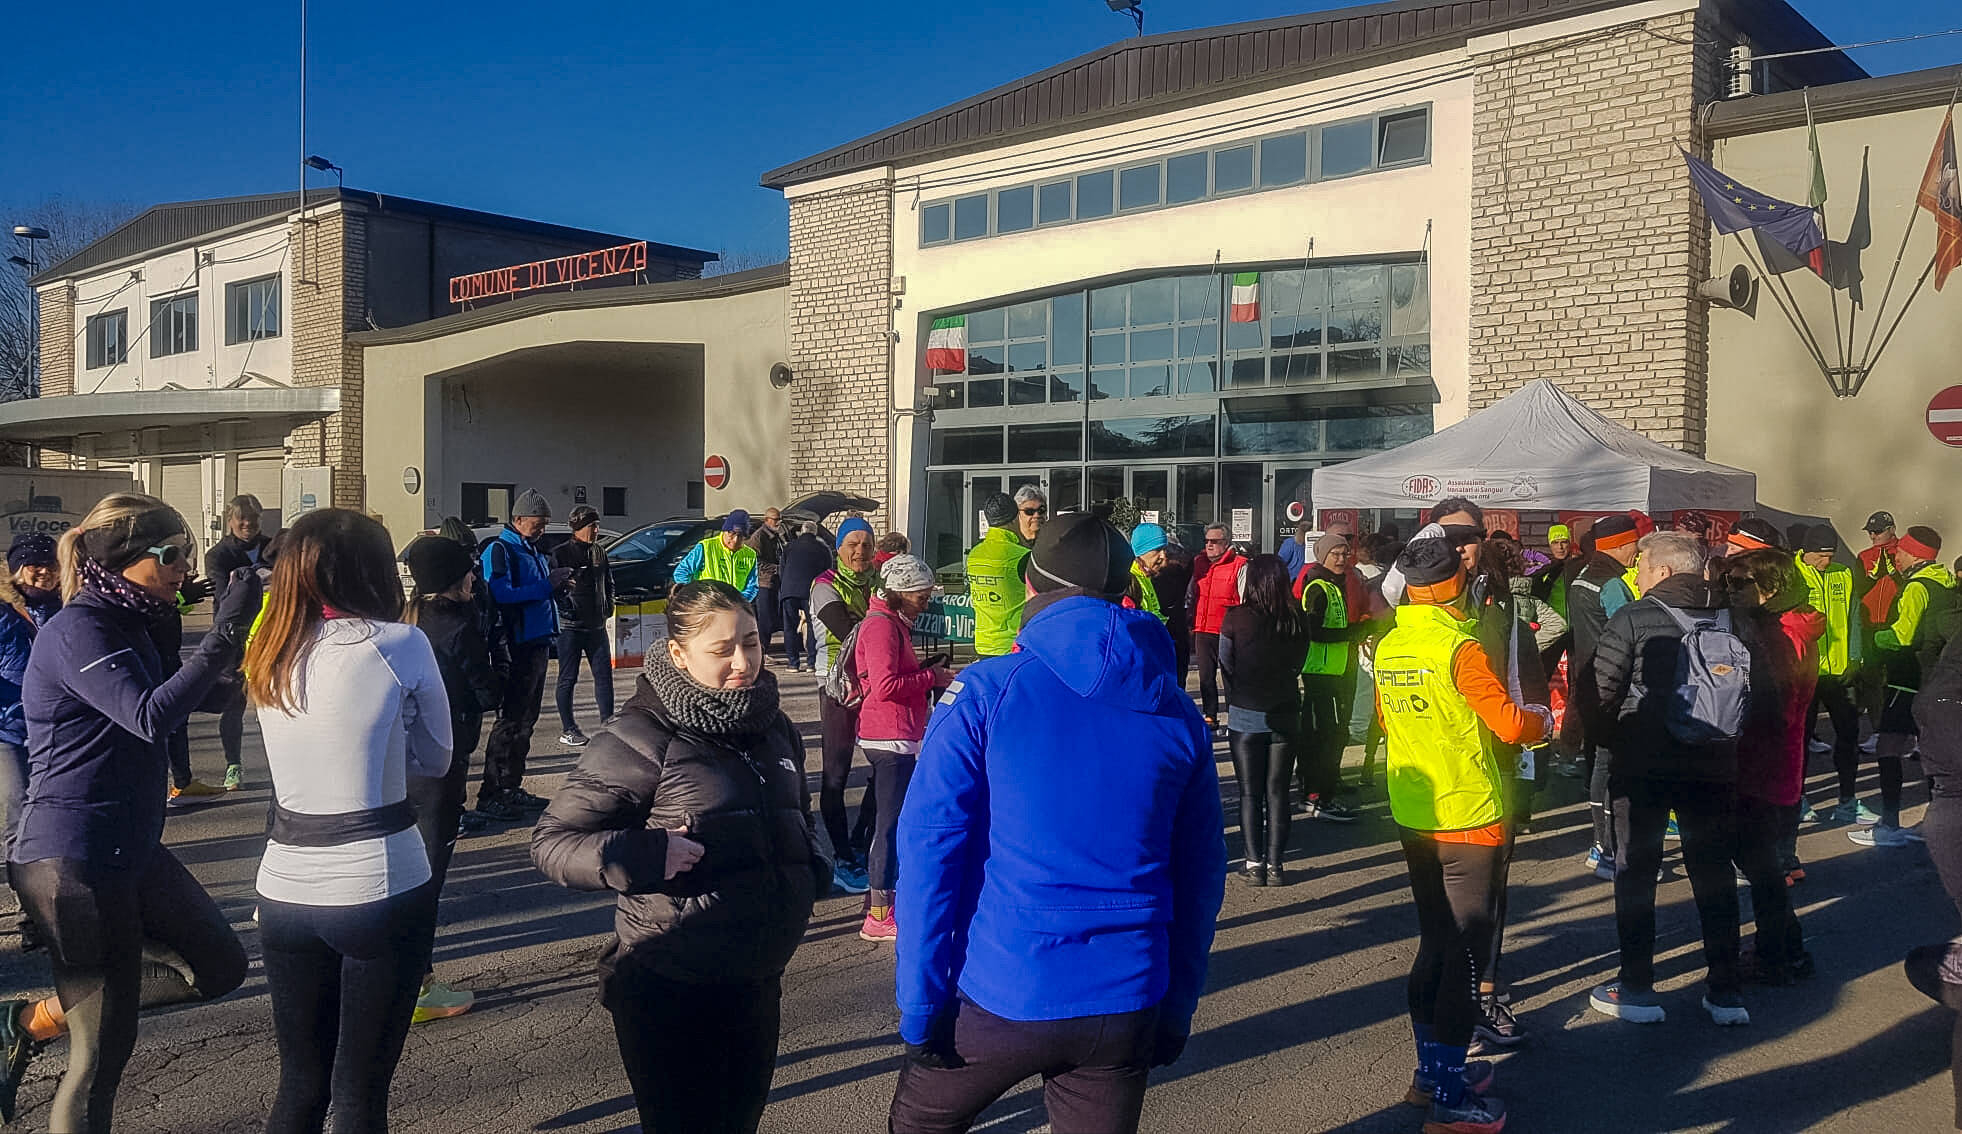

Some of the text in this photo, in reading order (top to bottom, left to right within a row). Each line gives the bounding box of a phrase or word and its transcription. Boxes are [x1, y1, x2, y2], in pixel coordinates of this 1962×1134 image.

[450, 241, 647, 302] COMUNE DI VICENZA
[1409, 478, 1434, 493] FIDAS
[9, 517, 71, 531] Veloce
